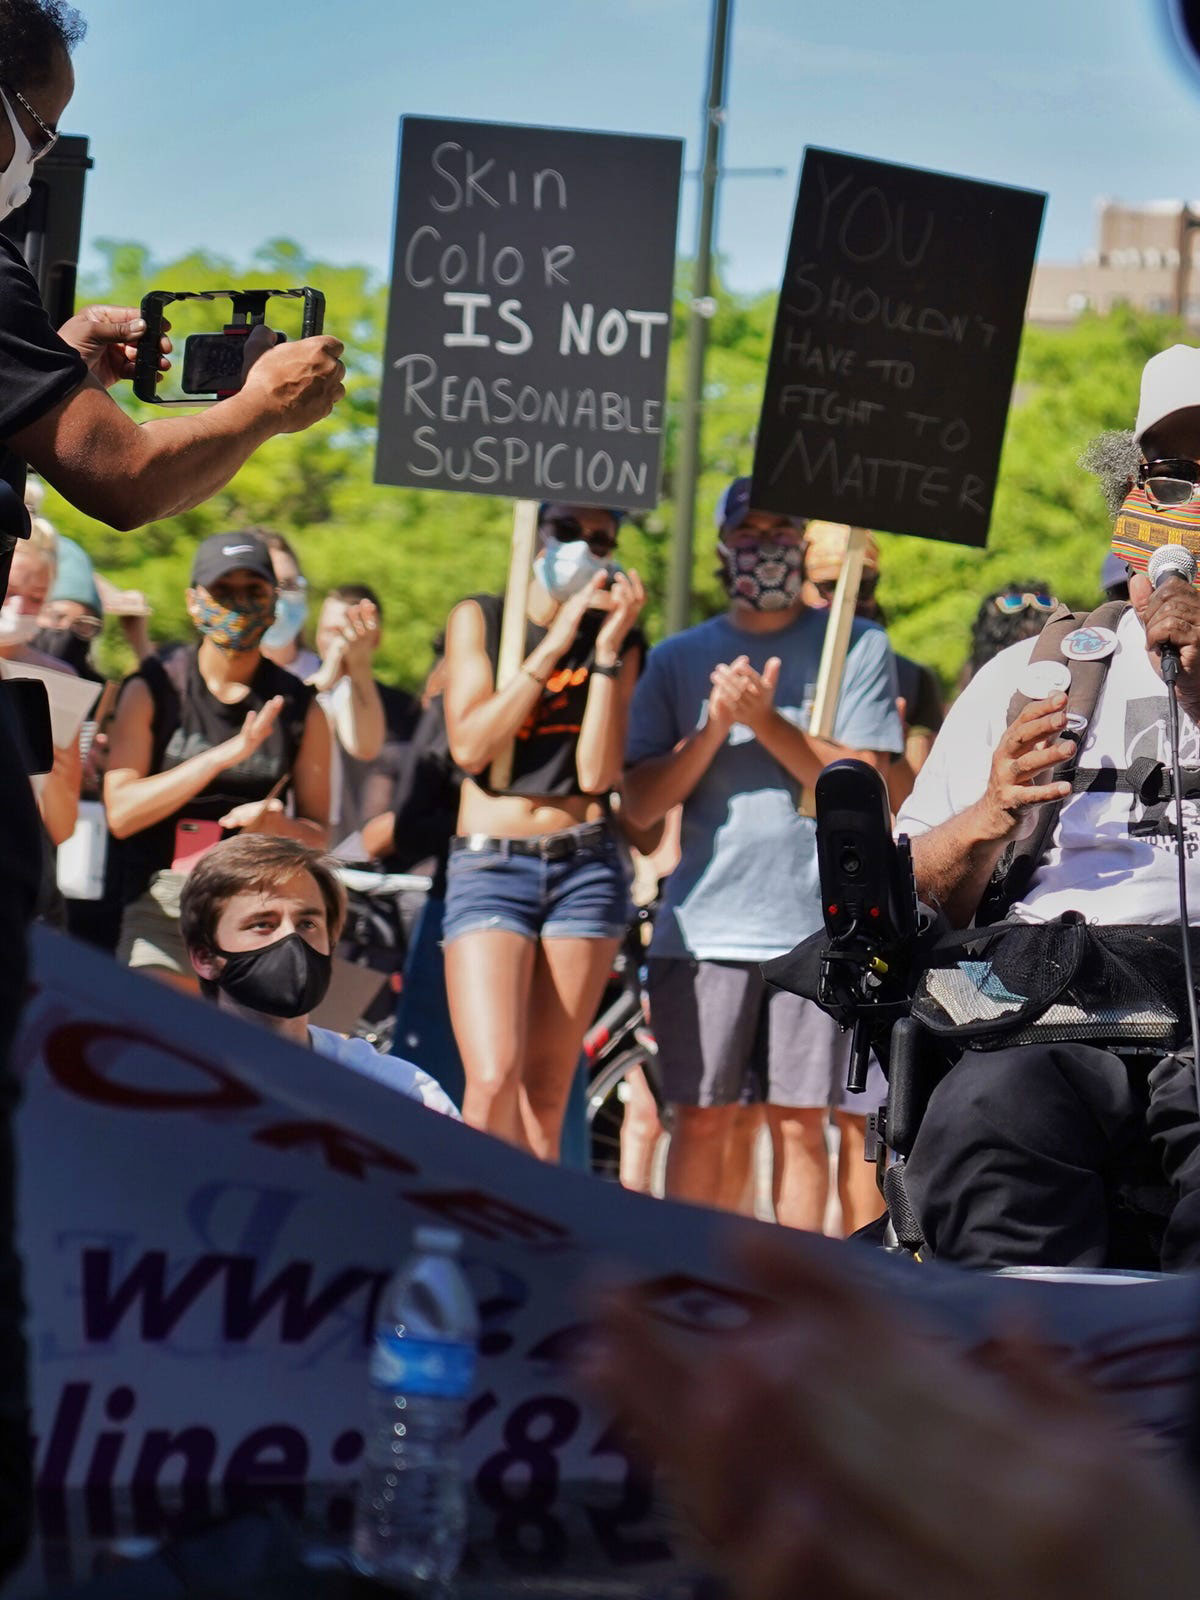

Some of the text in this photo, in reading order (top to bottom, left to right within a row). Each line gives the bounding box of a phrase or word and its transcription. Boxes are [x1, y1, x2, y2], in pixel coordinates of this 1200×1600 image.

[816, 162, 935, 268] YOU
[443, 291, 669, 359] IS NOT
[784, 327, 916, 389] HAVE TO
[393, 353, 664, 435] REASONABLE
[779, 383, 973, 453] FIGHT TO
[406, 425, 648, 495] SUSPICION
[769, 428, 988, 515] MATTER
